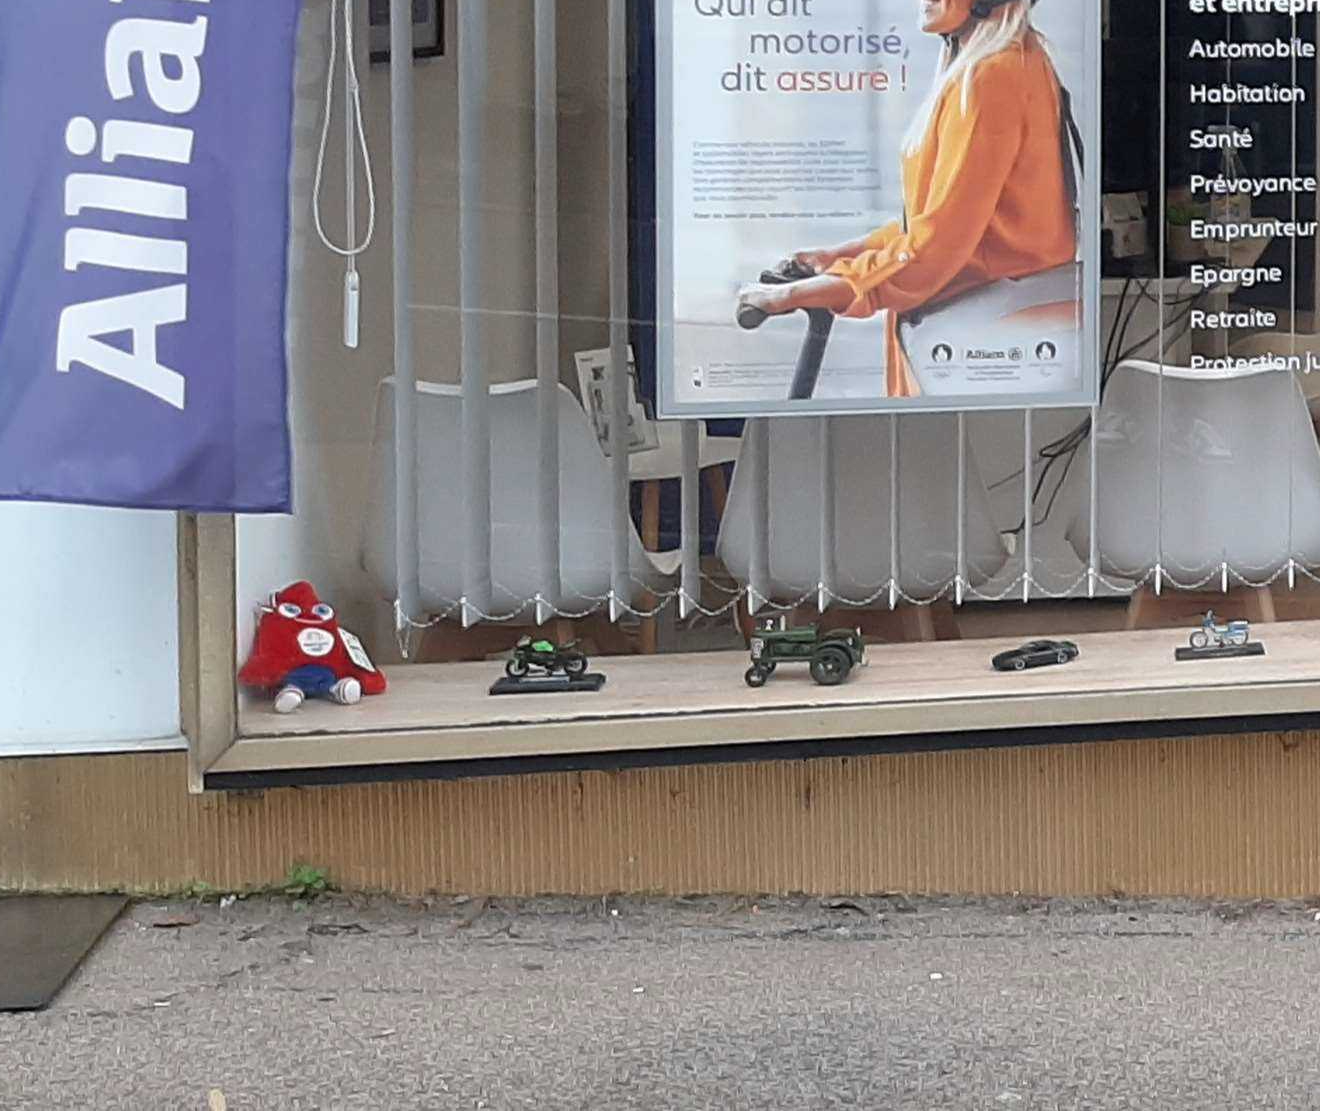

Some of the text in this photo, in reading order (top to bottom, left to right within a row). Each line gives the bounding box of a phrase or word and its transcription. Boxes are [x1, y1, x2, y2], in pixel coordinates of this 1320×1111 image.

[749, 25, 912, 61] motorisé,
[1188, 37, 1316, 58] Automobile
[721, 62, 768, 93] dit
[776, 63, 890, 92] assuré
[1189, 84, 1306, 104] Habitation
[1189, 128, 1254, 149] Santé
[1189, 174, 1318, 196] Prévoyance
[1190, 219, 1319, 242] Emprunteur
[1190, 265, 1282, 286] Epargne
[1190, 308, 1277, 329] Retraite
[1190, 352, 1300, 372] Protection
